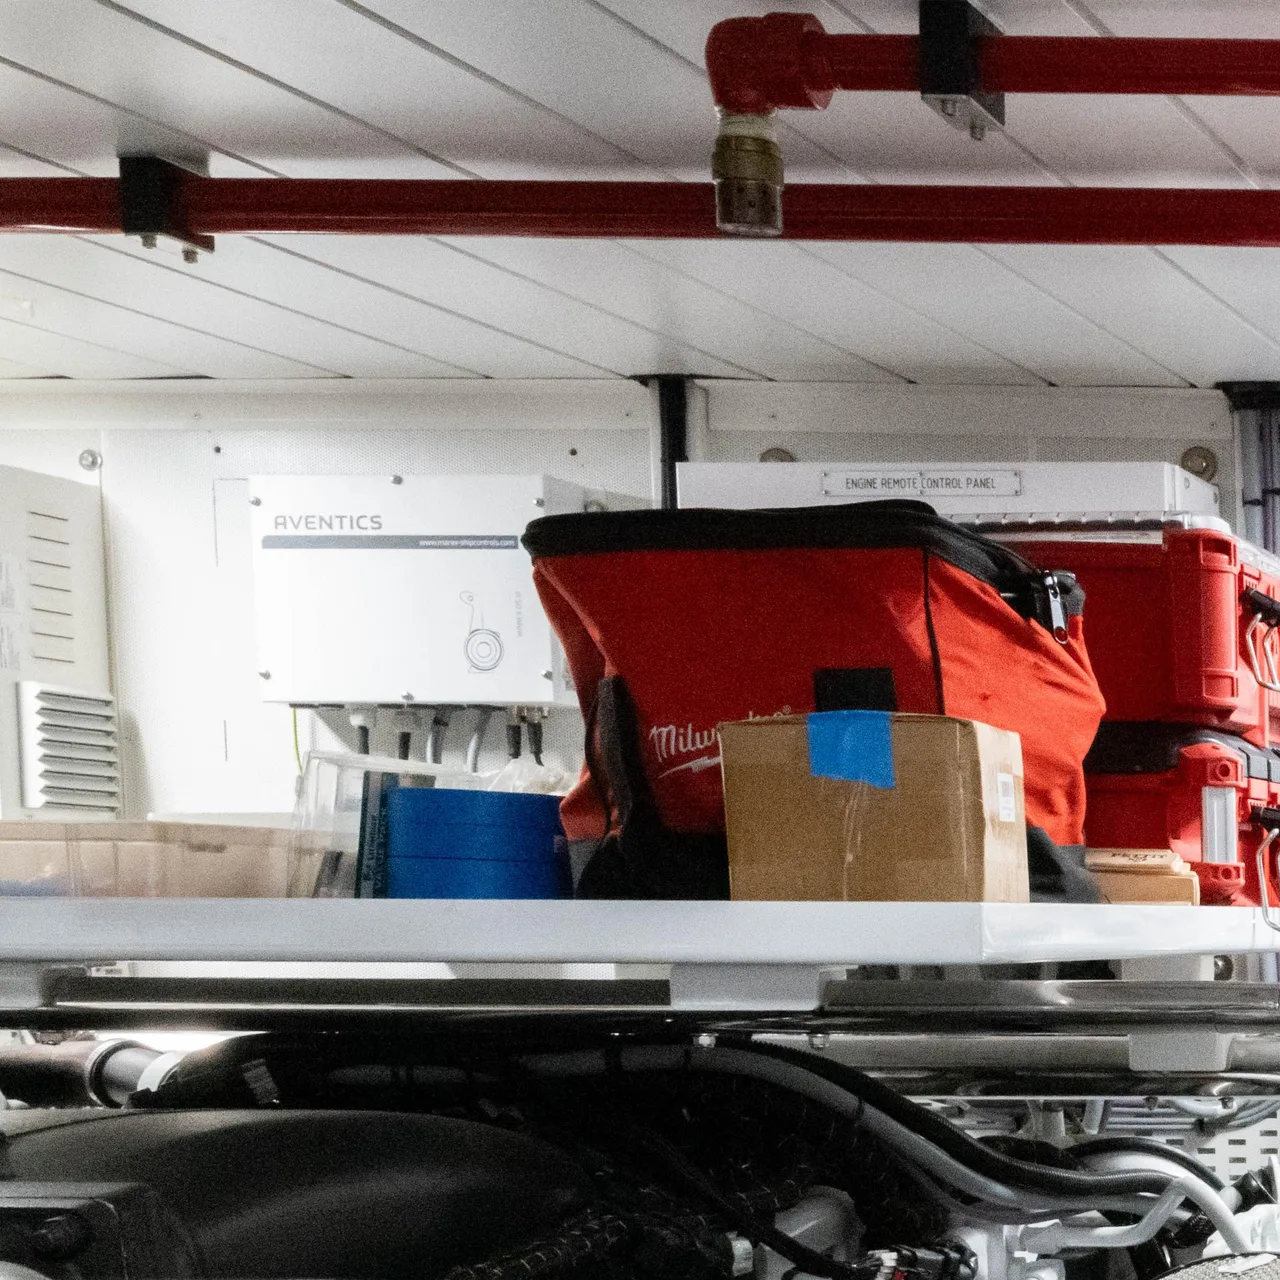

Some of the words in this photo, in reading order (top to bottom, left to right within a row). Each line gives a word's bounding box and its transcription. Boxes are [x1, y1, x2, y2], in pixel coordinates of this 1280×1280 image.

[845, 477, 878, 490] ENGINE
[880, 477, 917, 490] REMOTE
[921, 477, 961, 490] CONTROL
[964, 477, 997, 490] PANEL
[273, 514, 382, 530] AVENTICS
